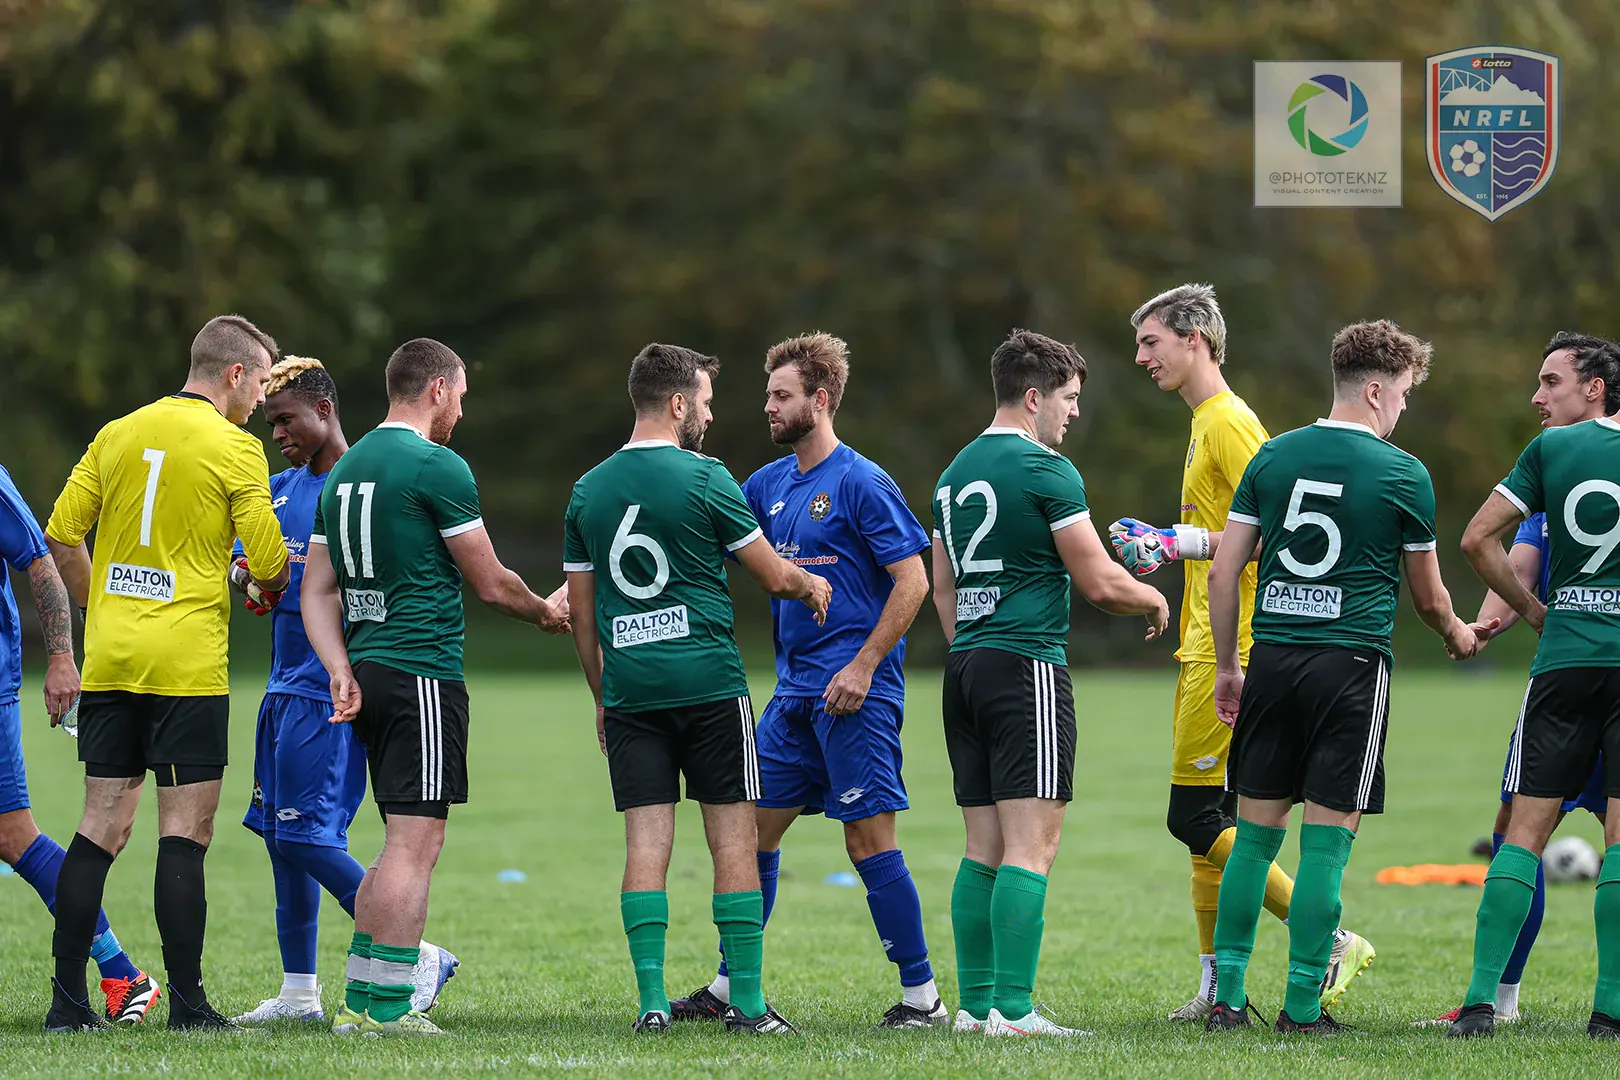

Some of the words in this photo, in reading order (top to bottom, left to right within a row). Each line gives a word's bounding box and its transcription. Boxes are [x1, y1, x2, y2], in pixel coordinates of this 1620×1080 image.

[140, 448, 166, 546] 1
[1564, 480, 1620, 573] 9
[336, 482, 375, 578] 11
[609, 505, 669, 599] 6
[936, 481, 1003, 577] 12
[1278, 479, 1343, 577] 5
[110, 582, 170, 598] ELECTRICAL
[112, 567, 171, 588] DALTON
[1266, 599, 1336, 615] ELECTRICAL
[1268, 579, 1338, 604] DALTON
[616, 609, 683, 634] DALTON
[617, 625, 685, 644] ELECTRICAL
